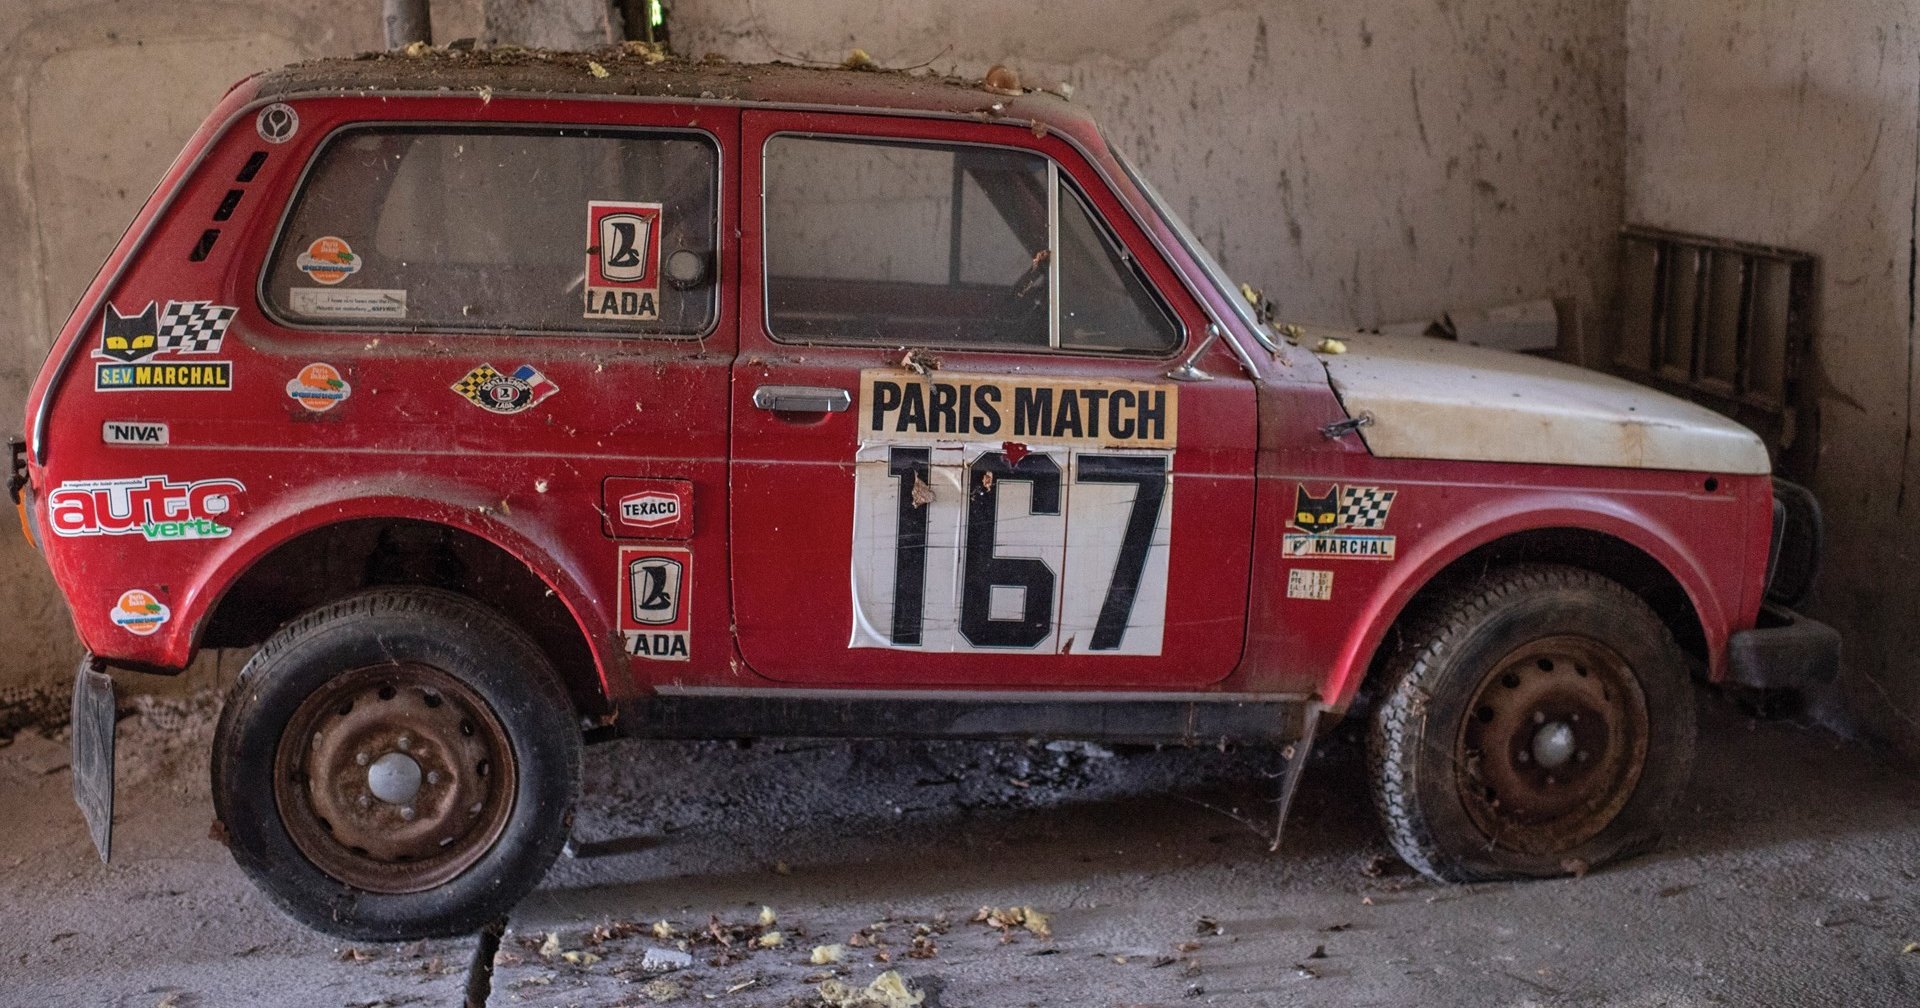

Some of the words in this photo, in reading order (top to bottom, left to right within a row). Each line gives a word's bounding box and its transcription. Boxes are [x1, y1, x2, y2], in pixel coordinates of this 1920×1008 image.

[587, 291, 657, 316] LADA
[101, 368, 132, 384] S.E.V.
[136, 367, 227, 385] MARCHAL
[871, 381, 1002, 435] PARIS
[1014, 387, 1167, 440] MATCH
[108, 425, 163, 441] "NIVA"
[53, 480, 239, 531] auto
[623, 502, 676, 516] TEXACO
[888, 446, 1169, 652] 167
[1315, 540, 1388, 555] MARCHAL
[626, 634, 688, 656] ADA
